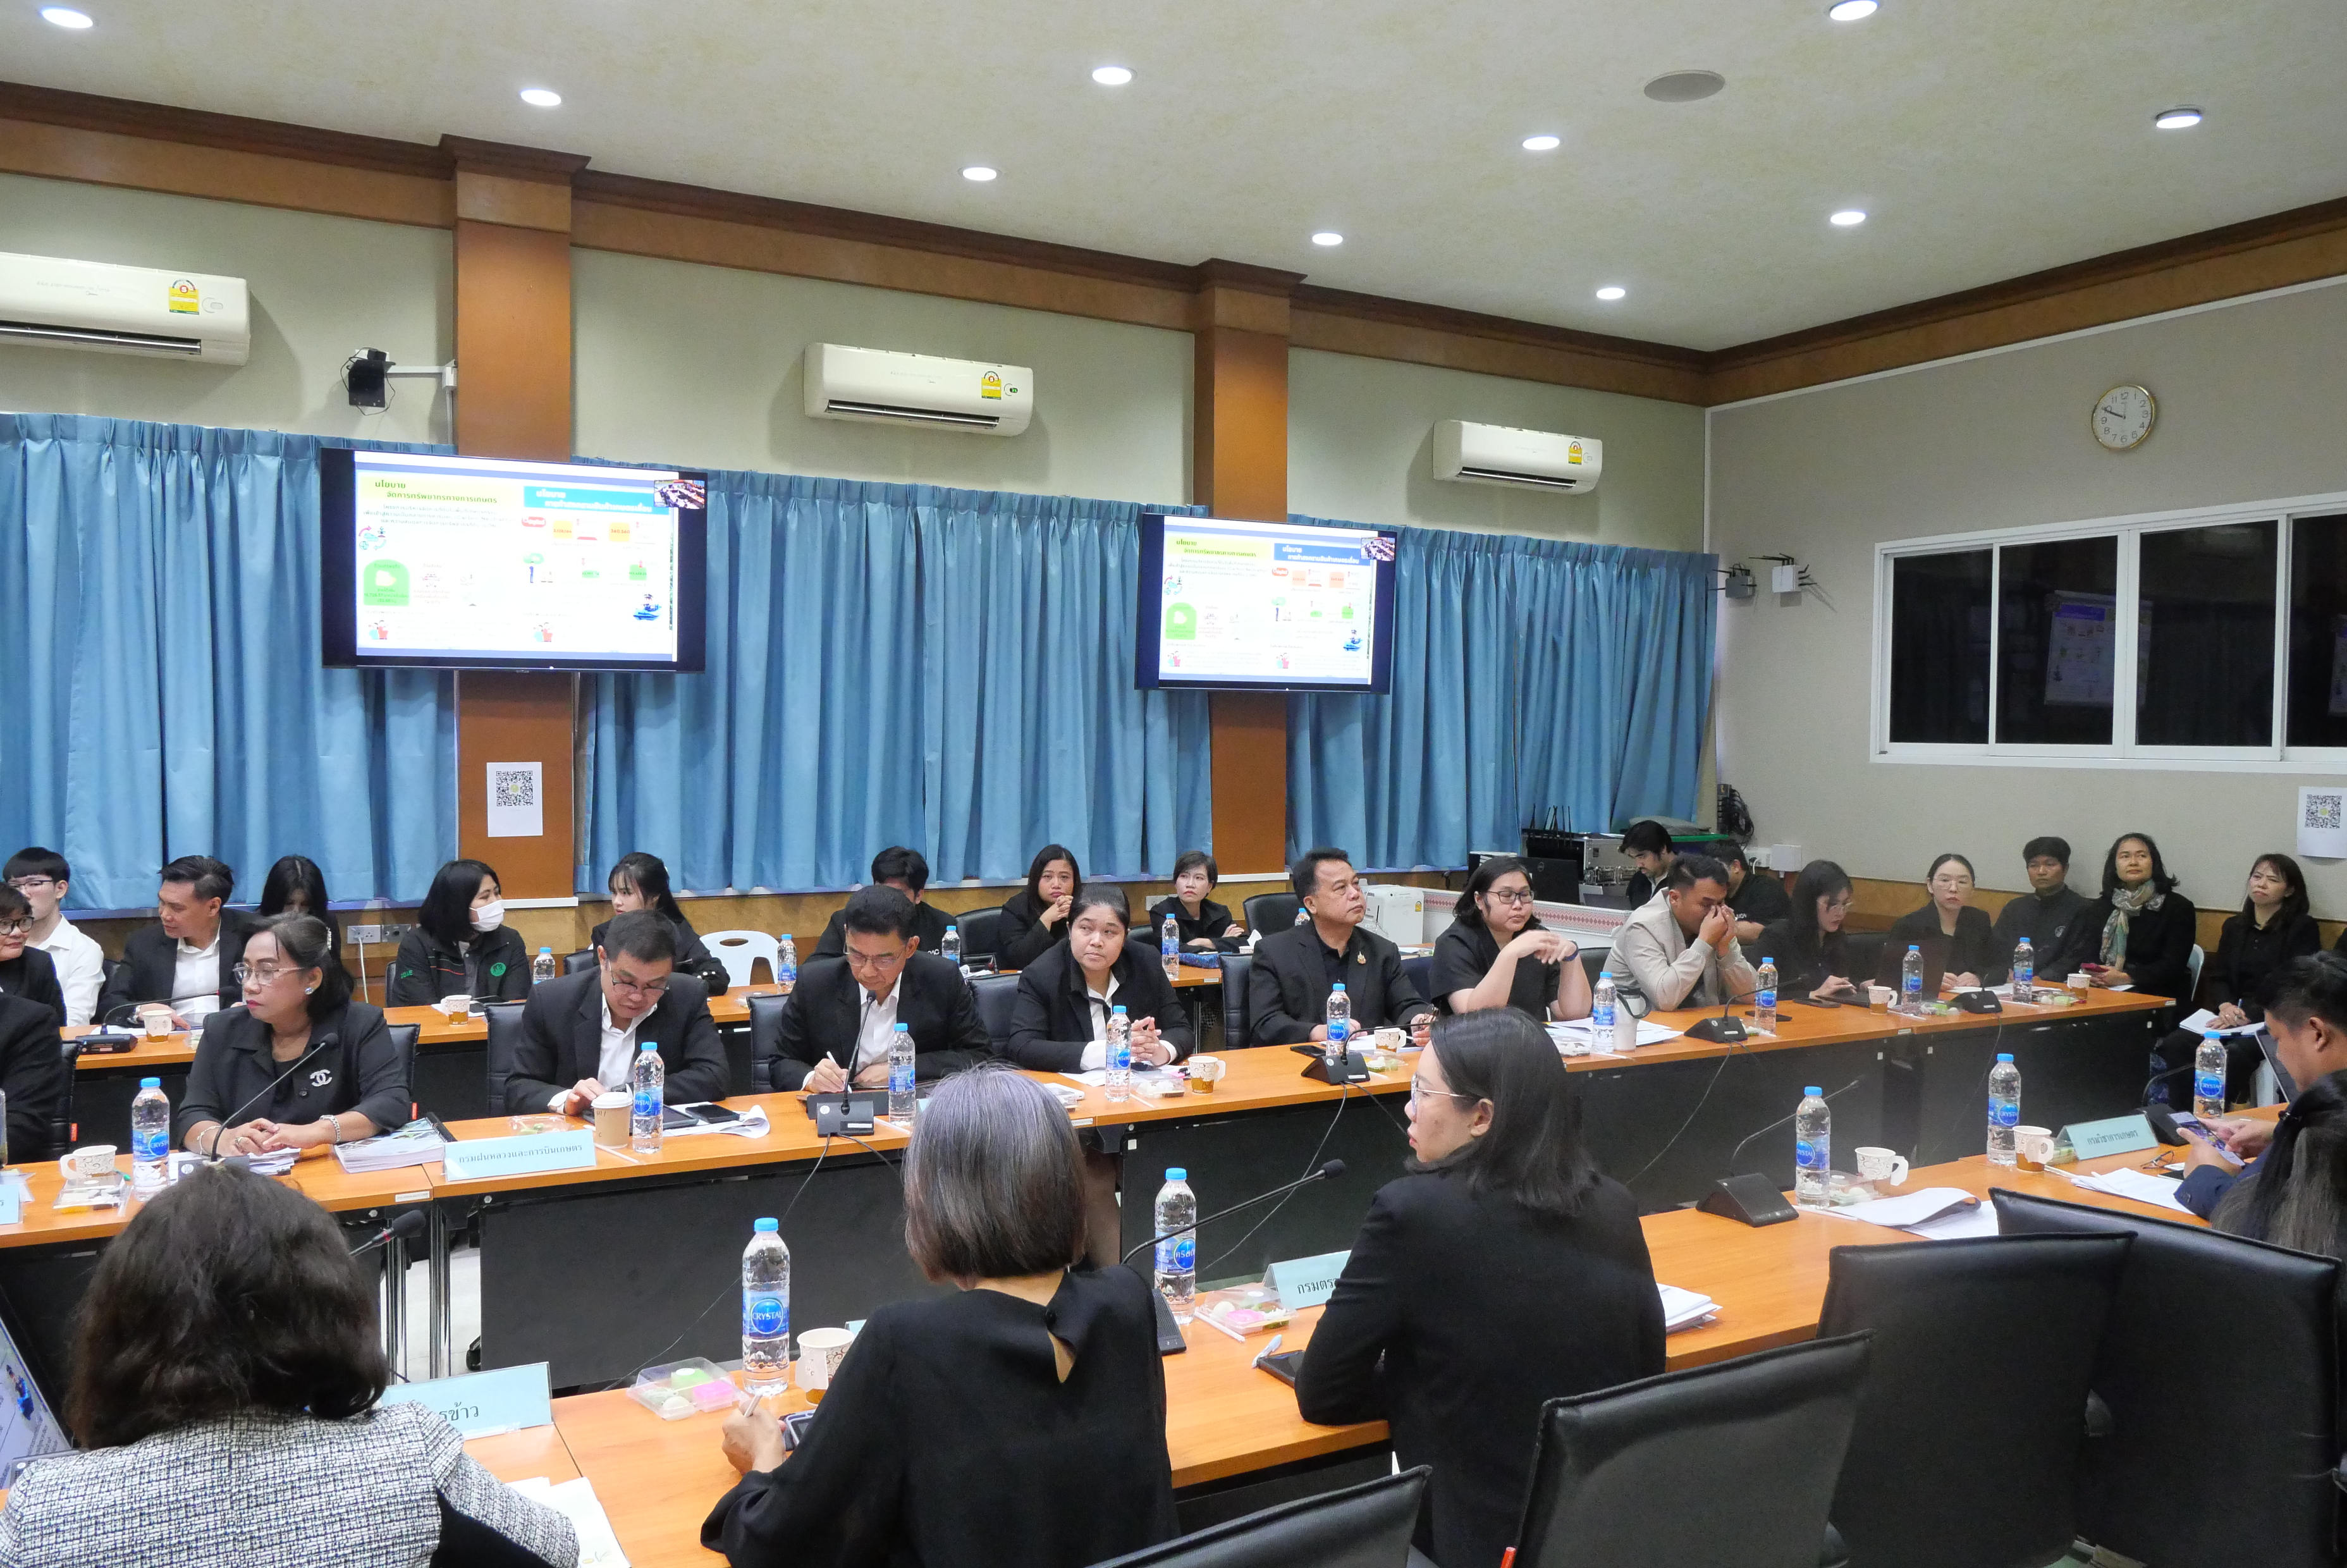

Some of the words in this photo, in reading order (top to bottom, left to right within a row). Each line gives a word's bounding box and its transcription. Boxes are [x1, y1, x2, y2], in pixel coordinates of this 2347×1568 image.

[2111, 395, 2117, 404] 11
[375, 479, 406, 489] นโยบาย
[386, 491, 498, 504] จัดการทรัพยากรทางการเกษตร
[2087, 1130, 2139, 1146] กรมวิชาการเกษตร
[459, 1144, 583, 1163] กรมฝนหลวงและการบินเกษตร
[1297, 1278, 1337, 1294] กรมตร
[752, 1311, 782, 1320] CRYSTAL
